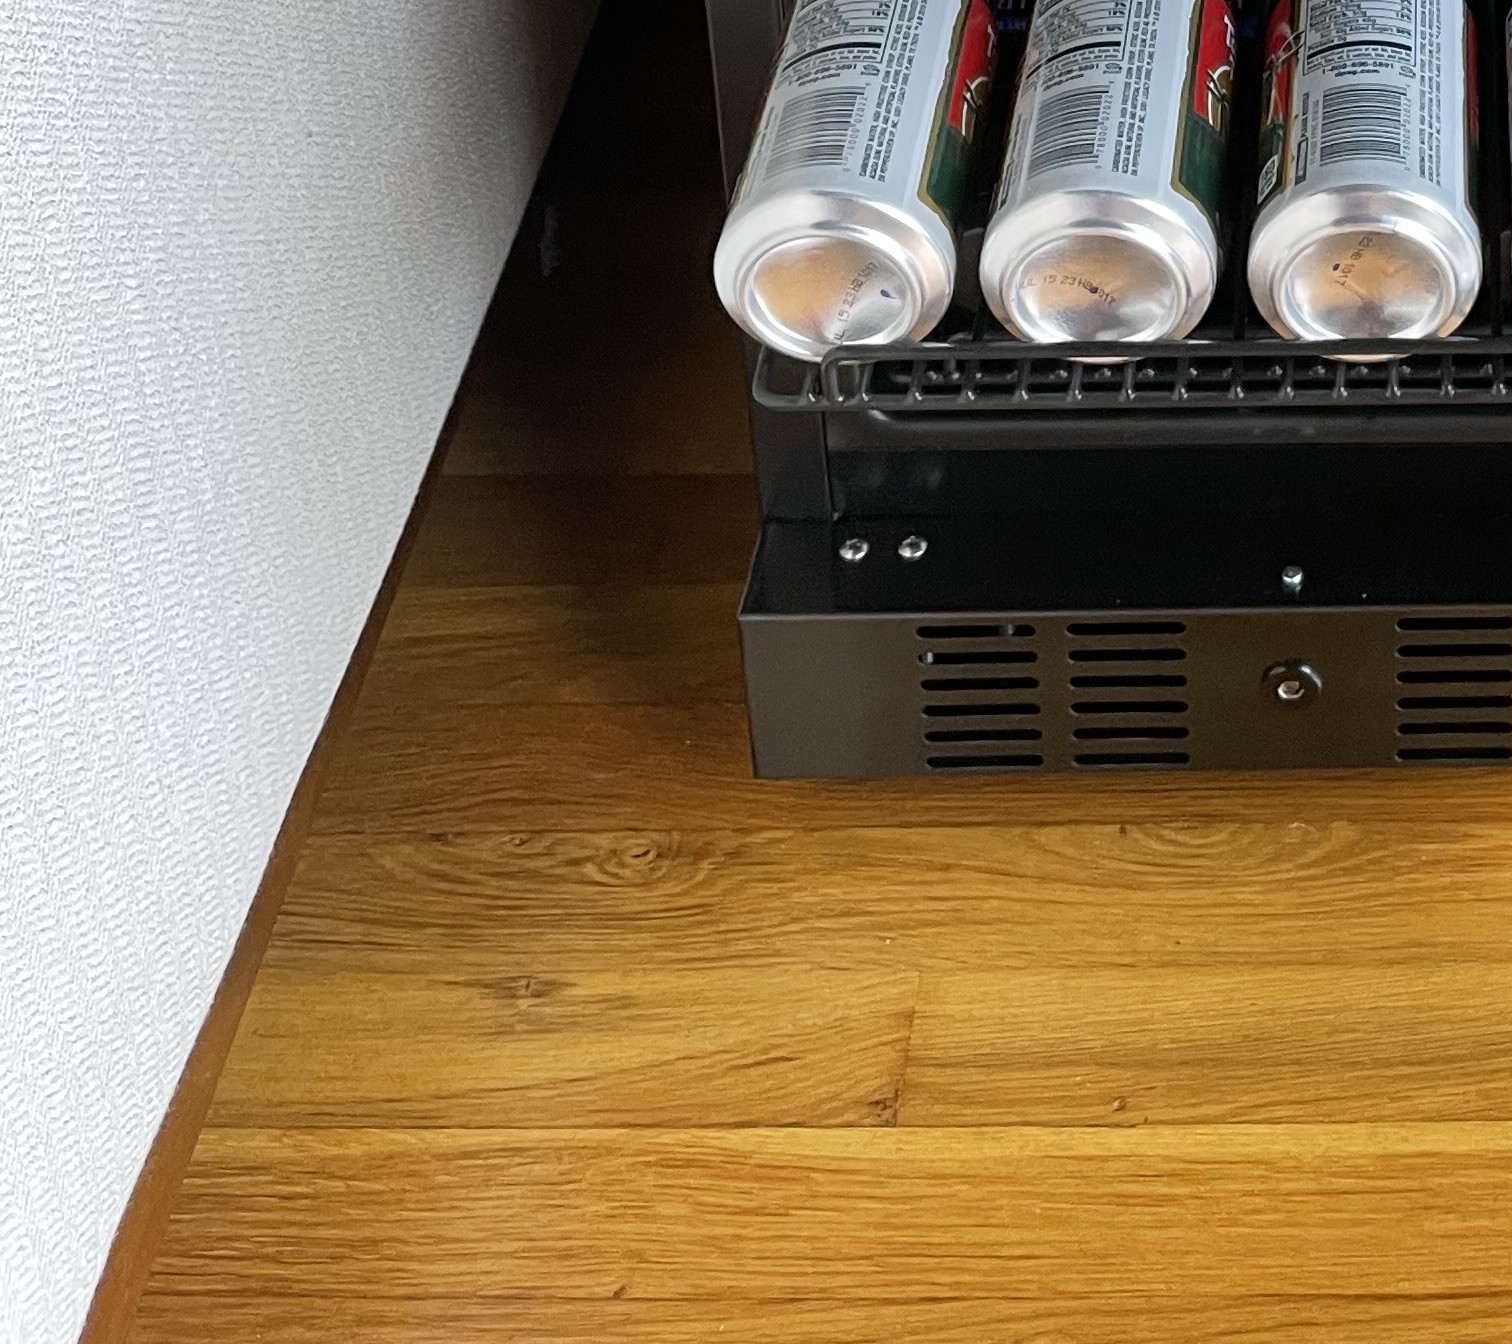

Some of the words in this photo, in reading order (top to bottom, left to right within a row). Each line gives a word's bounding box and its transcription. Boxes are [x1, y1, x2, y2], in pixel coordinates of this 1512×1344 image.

[1043, 274, 1058, 285] 15
[1060, 275, 1077, 287] 23
[838, 309, 850, 323] 15
